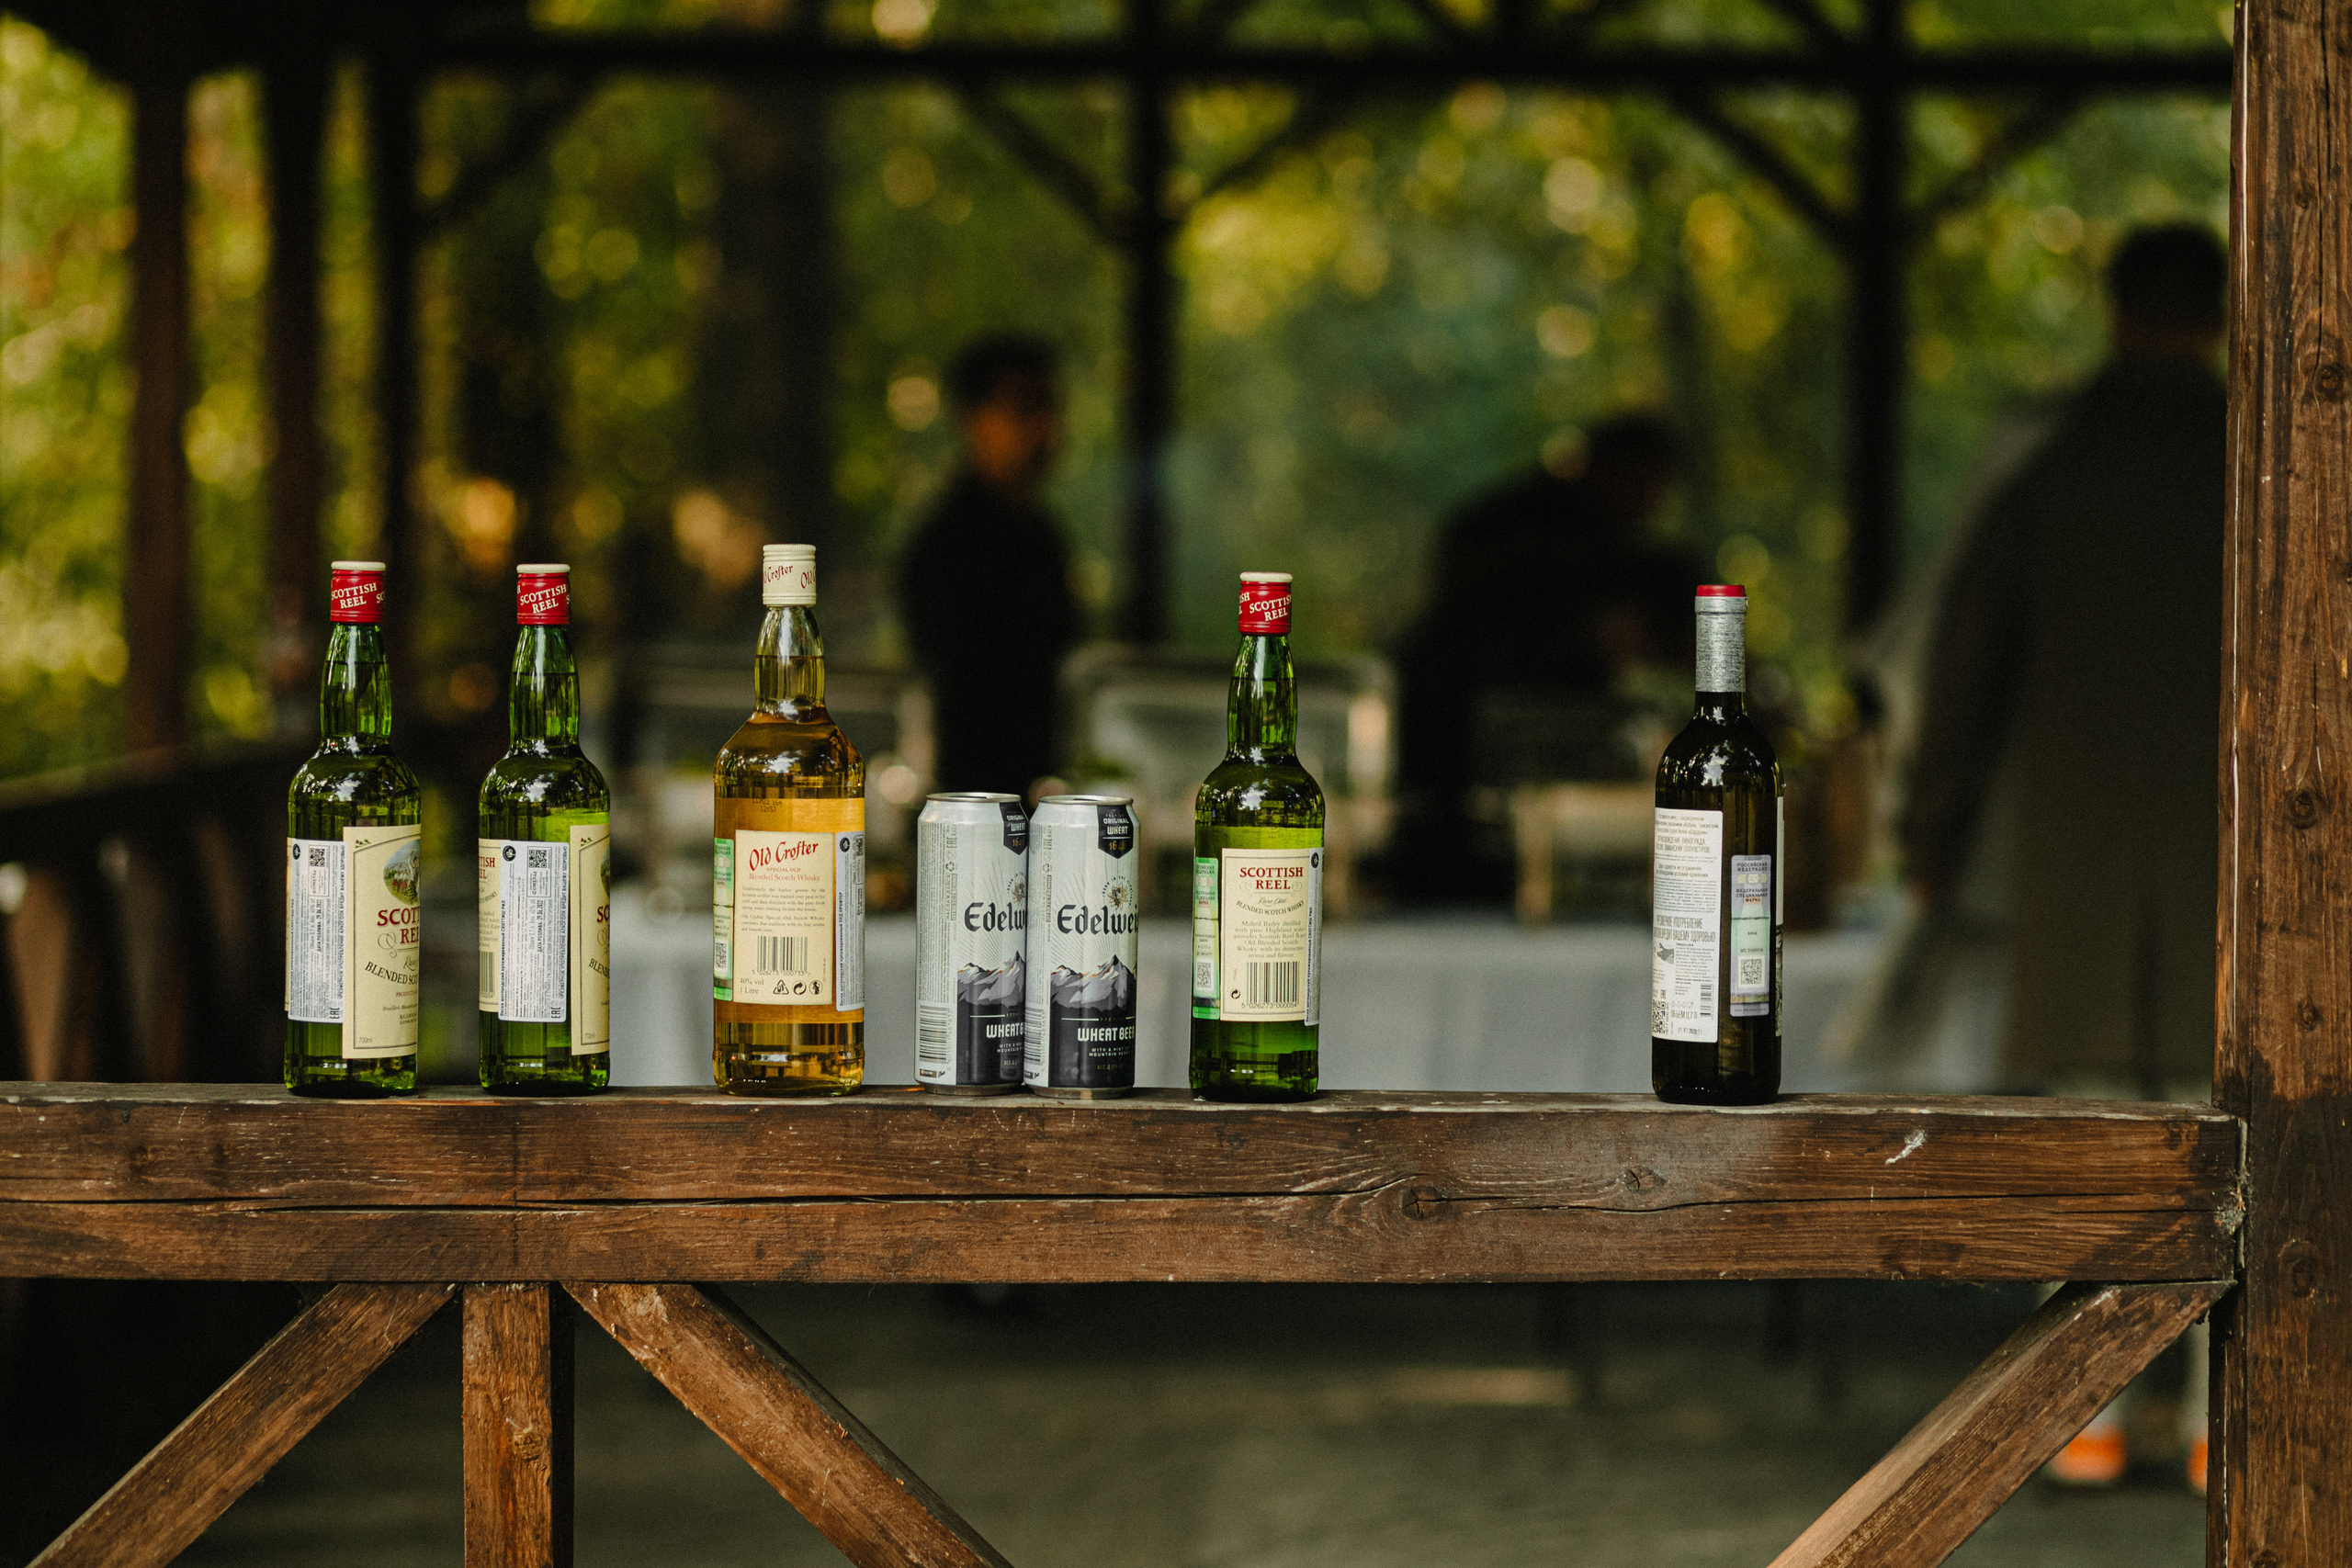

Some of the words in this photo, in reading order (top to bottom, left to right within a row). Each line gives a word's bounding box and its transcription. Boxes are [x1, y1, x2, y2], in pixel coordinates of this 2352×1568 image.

[767, 565, 793, 583] Crofter
[332, 582, 377, 601] SCOTTISH
[520, 583, 567, 606] SCOTTISH
[340, 595, 368, 609] REEL
[532, 597, 559, 614] REEL
[1250, 595, 1291, 615] SCOTTIS
[1264, 607, 1288, 622] REEL
[1107, 825, 1129, 835] WHEAT
[749, 847, 771, 872] Old
[775, 840, 819, 863] Crofter
[749, 873, 773, 882] Blended
[775, 874, 796, 882] Scotch
[797, 874, 820, 883] Whisky
[1239, 867, 1304, 878] SCOTTISH
[1255, 879, 1291, 890] REEL
[1236, 899, 1264, 915] BLENDED
[1264, 908, 1287, 916] SCOTCH
[1287, 900, 1305, 912] WHISKY
[377, 907, 420, 927] SCOT
[965, 901, 1026, 932] Edelw
[1057, 904, 1138, 935] Edelwei
[1673, 916, 1703, 930] УПОТРЕБЛЕНИЕ
[401, 927, 419, 944] RE
[1250, 928, 1262, 936] pure
[365, 962, 408, 985] BLENDED
[986, 1022, 1020, 1039] WHEAT
[1077, 1027, 1118, 1042] WHEAT
